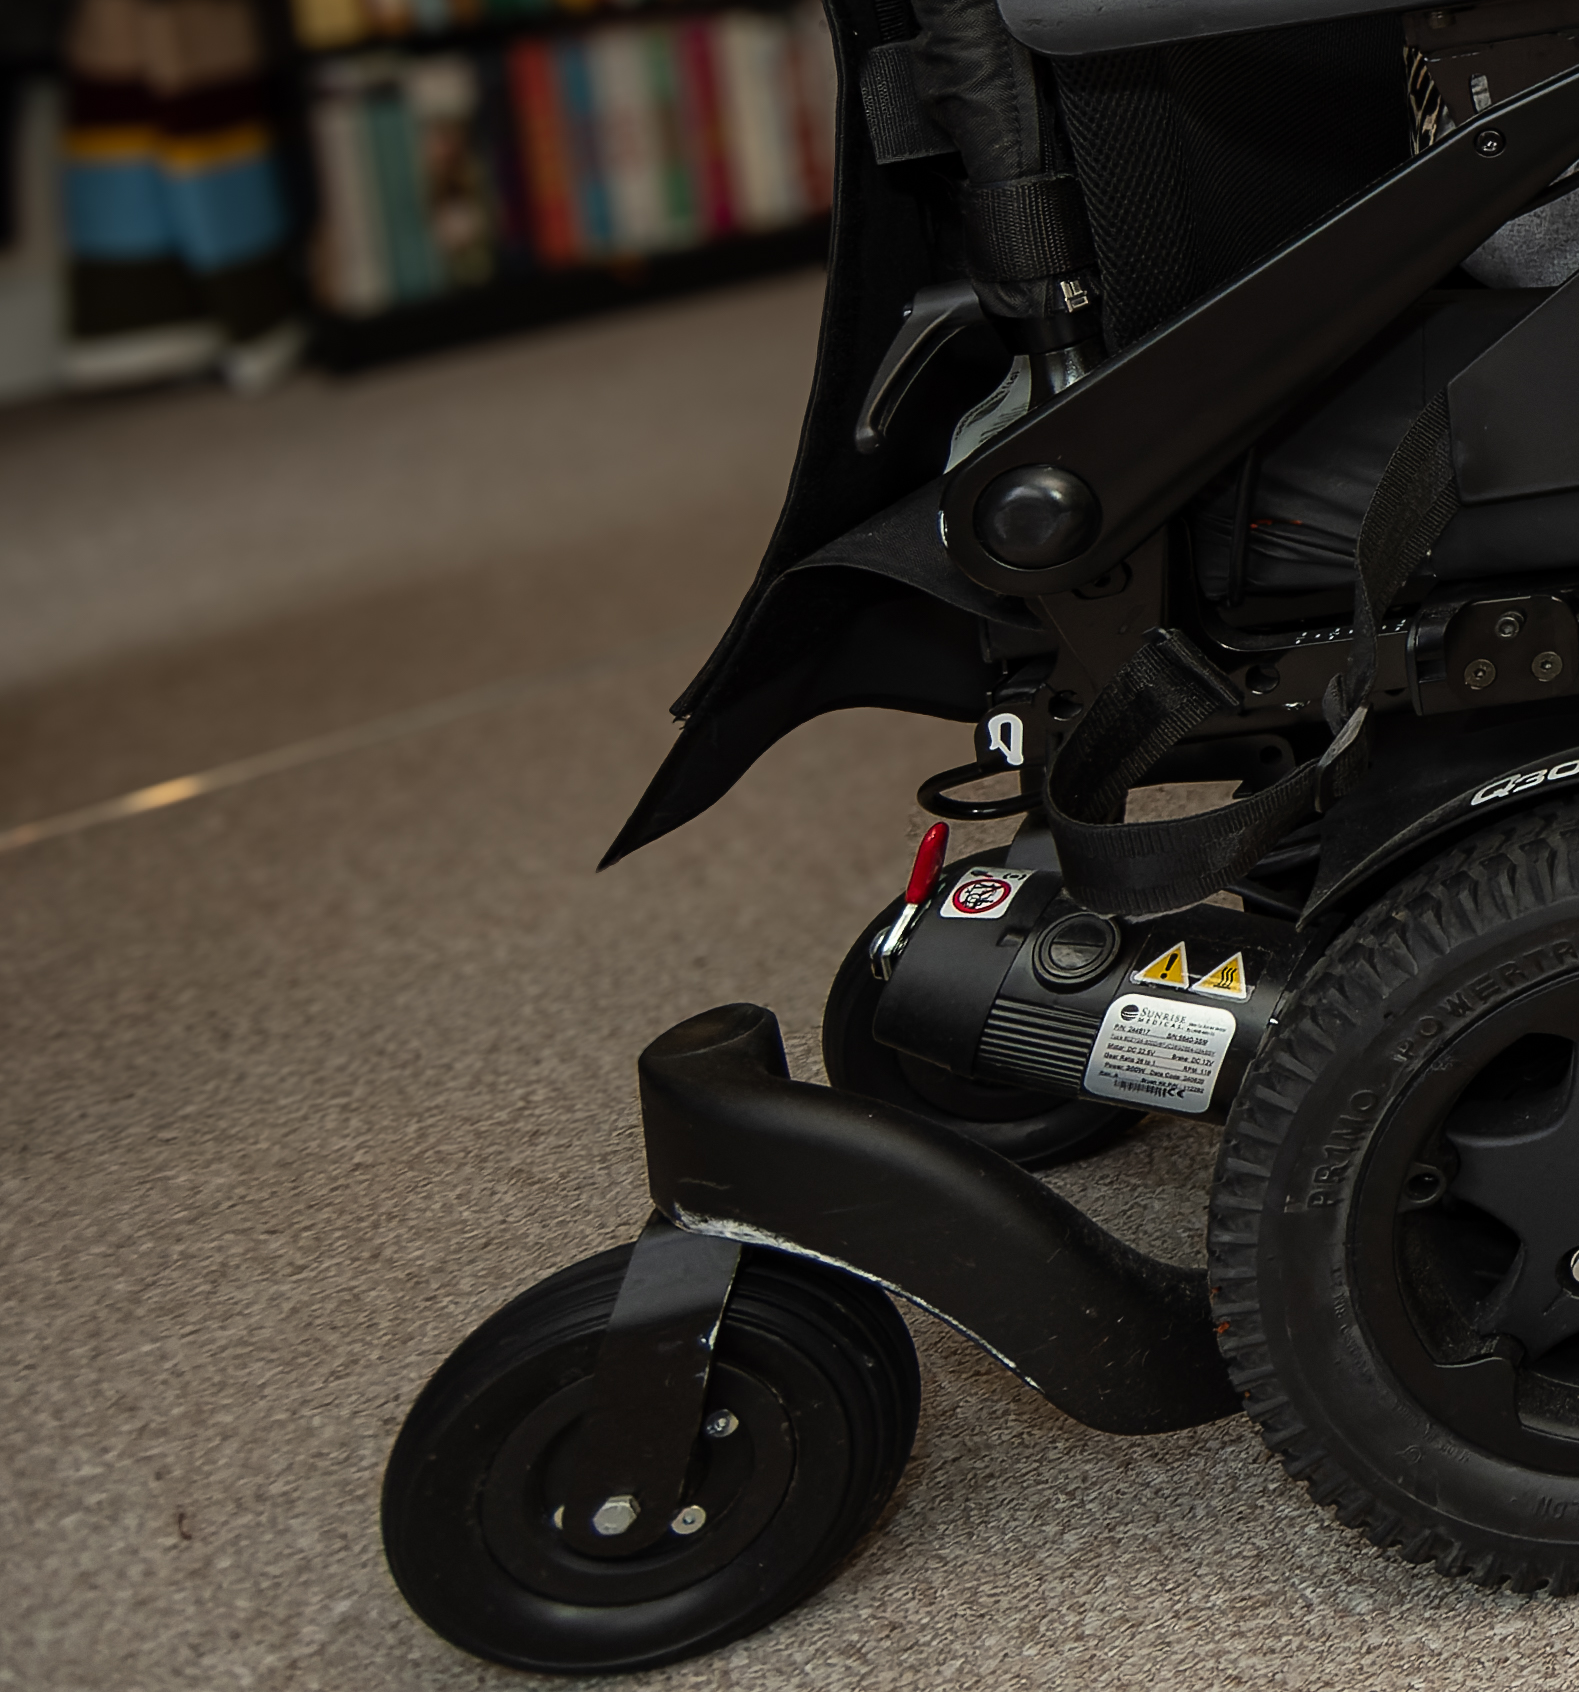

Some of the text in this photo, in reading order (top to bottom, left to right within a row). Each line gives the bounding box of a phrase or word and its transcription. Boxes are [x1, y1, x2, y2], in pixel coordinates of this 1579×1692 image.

[1140, 1007, 1187, 1023] SUNRISE
[1138, 1017, 1182, 1030] MEDICAL
[1308, 1088, 1379, 1212] PRIMO
